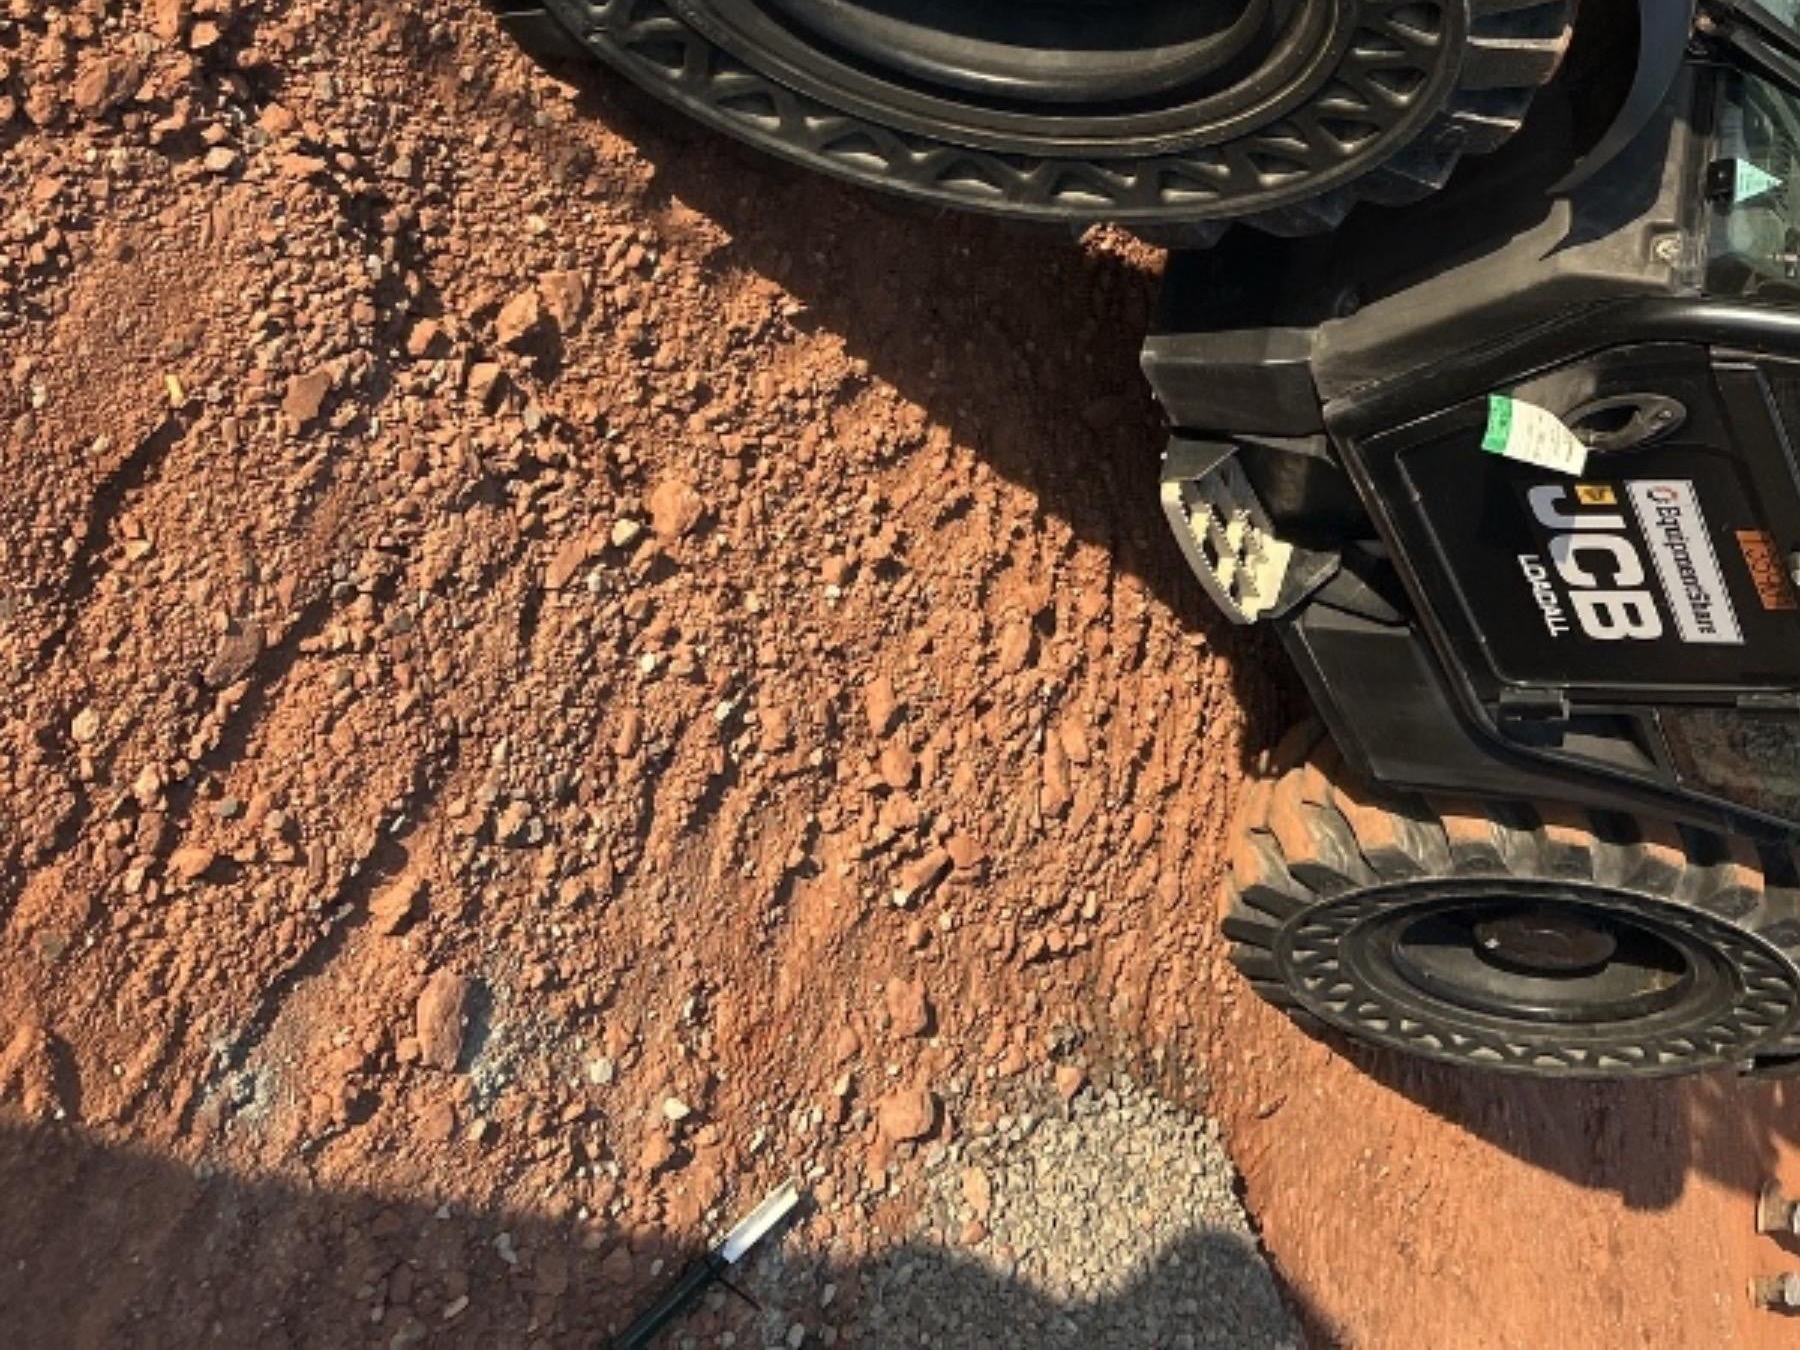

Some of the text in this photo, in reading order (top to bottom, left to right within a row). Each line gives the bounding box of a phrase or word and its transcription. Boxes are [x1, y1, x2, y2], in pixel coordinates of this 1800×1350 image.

[1518, 554, 1569, 637] LOADALL
[1526, 485, 1664, 641] JCB
[1655, 506, 1718, 635] EquipmentShare
